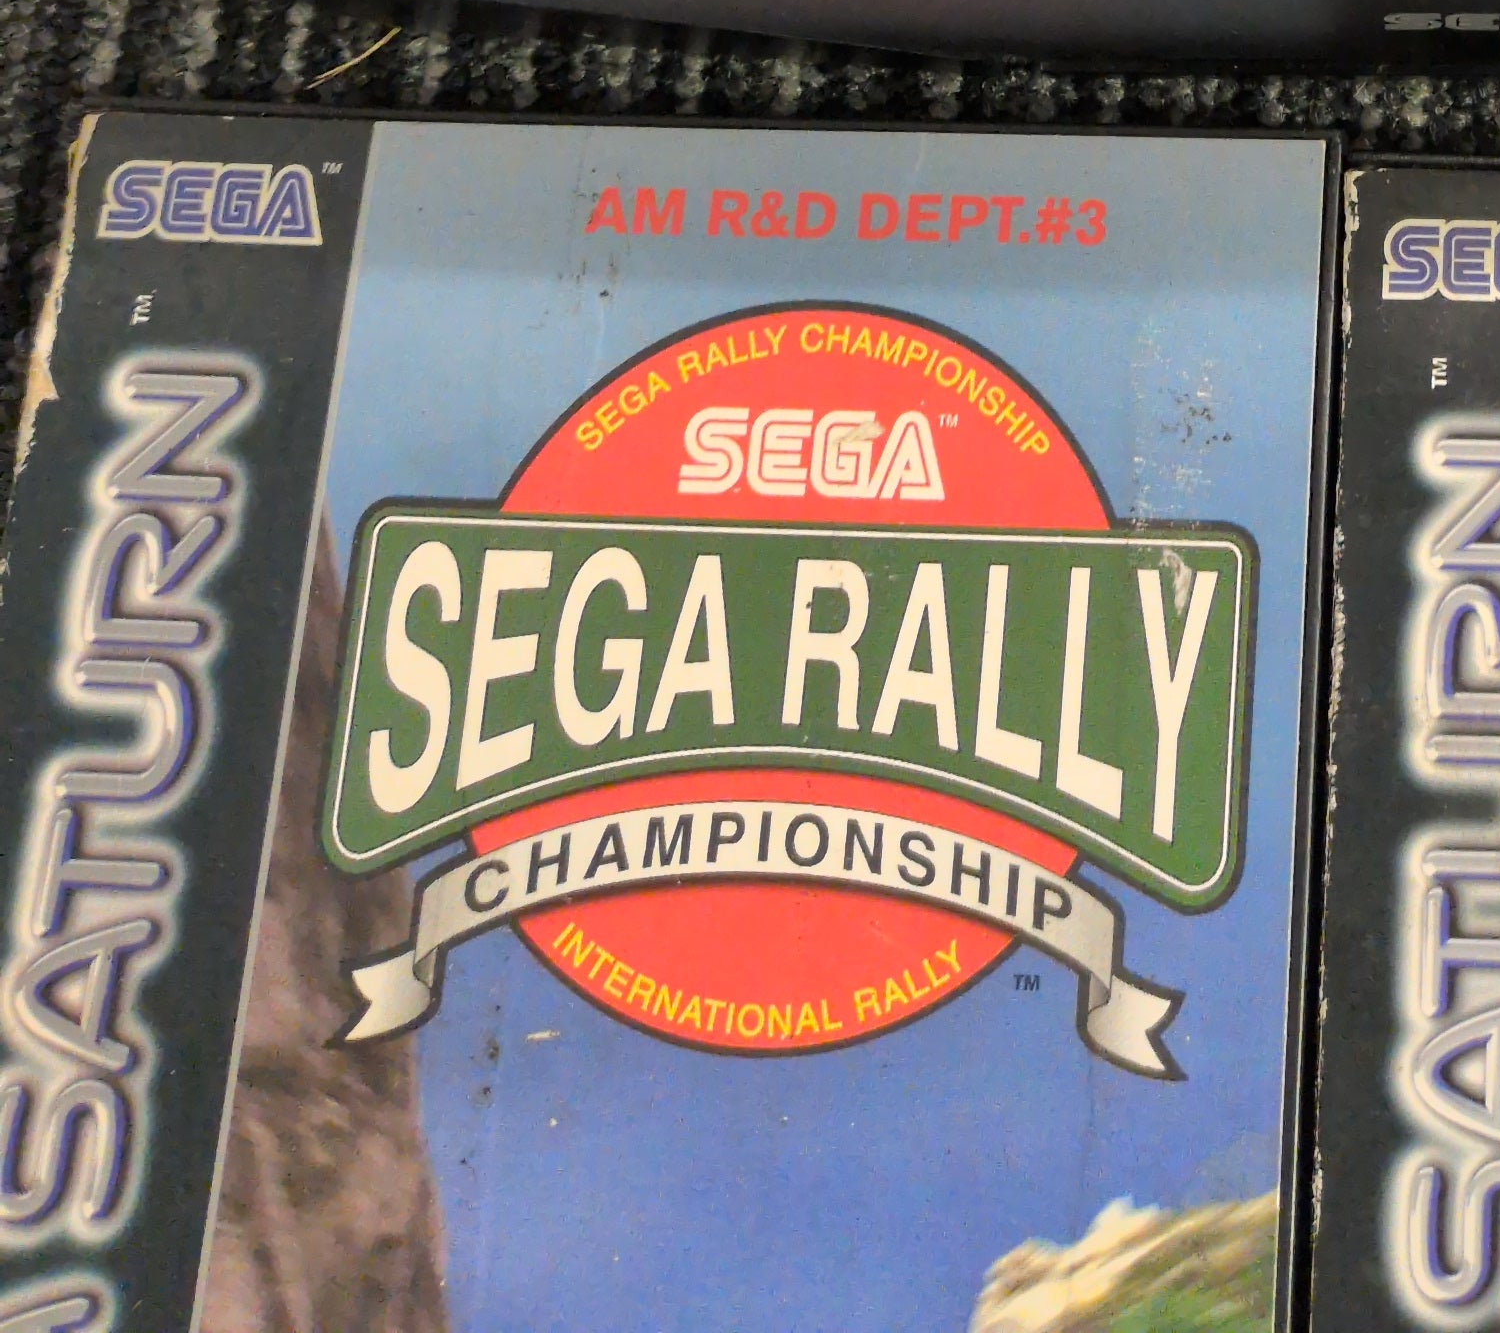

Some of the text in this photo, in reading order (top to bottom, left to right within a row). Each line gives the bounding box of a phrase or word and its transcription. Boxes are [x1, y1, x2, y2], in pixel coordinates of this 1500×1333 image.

[98, 161, 322, 245] SEGA
[585, 187, 1109, 246] AM R&D DEPT.#3
[575, 322, 1053, 459] SEGA RALLY CHAMPIONSHIP
[677, 407, 946, 502] SEGA
[367, 539, 1220, 846] SEGA RALLY
[0, 370, 243, 1226] SATURN
[464, 810, 1074, 934] CHAMPIONSHIP
[552, 922, 965, 1041] INTERNATIONAL RALLY
